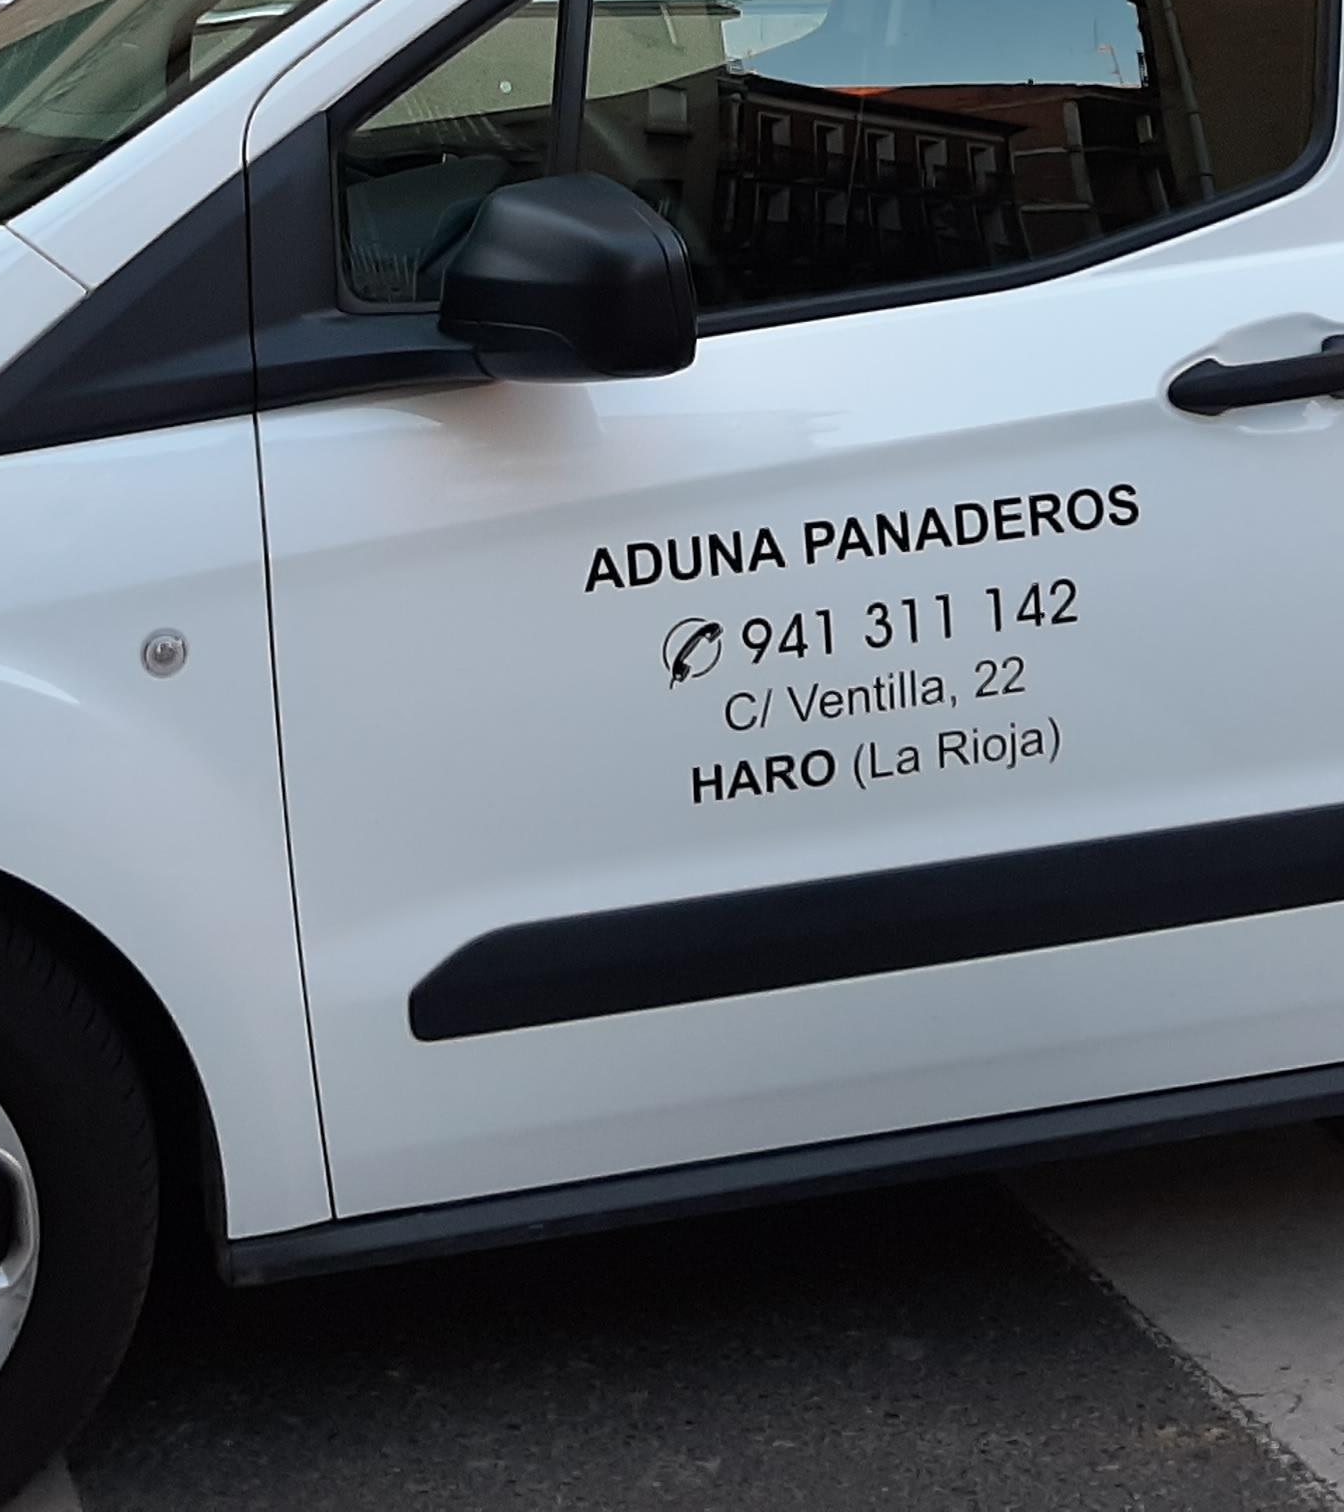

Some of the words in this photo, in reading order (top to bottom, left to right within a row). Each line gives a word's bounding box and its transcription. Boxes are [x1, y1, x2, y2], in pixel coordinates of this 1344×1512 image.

[584, 526, 787, 592] ADUNA
[803, 483, 1140, 565] PANADEROS
[742, 608, 834, 664] 941
[865, 593, 953, 648] 311
[985, 578, 1079, 632] 142
[724, 688, 773, 731] C/
[787, 669, 958, 723] Ventilla,
[974, 655, 1026, 698] 22
[691, 748, 836, 804] HARO
[853, 741, 921, 789] (La
[937, 717, 1062, 770] Rioja)
